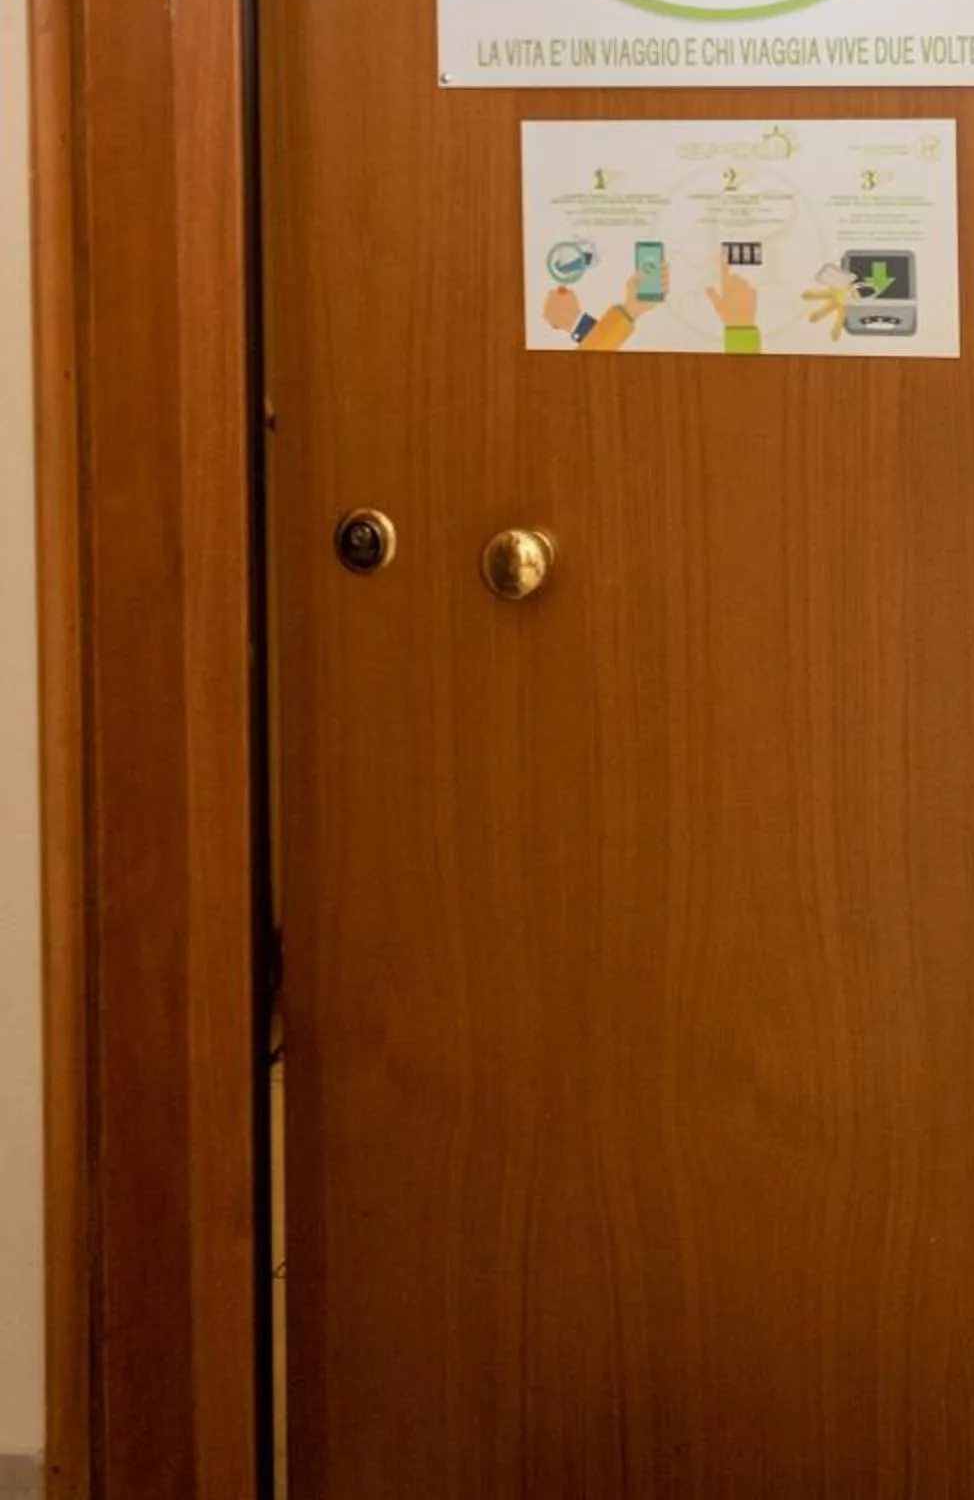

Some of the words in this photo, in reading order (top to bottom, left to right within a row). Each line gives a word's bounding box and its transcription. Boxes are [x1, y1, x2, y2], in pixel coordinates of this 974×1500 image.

[477, 39, 500, 67] LA
[504, 38, 546, 67] VITA
[570, 38, 596, 67] UN
[600, 37, 681, 67] VIAGGIO
[684, 37, 698, 66] E
[701, 37, 735, 66] CHI
[739, 36, 821, 66] VIAGGIA
[825, 36, 870, 66] VIVE
[874, 36, 916, 65] DUE
[594, 167, 606, 190] 1
[722, 167, 737, 191] 2
[860, 168, 877, 191] 3
